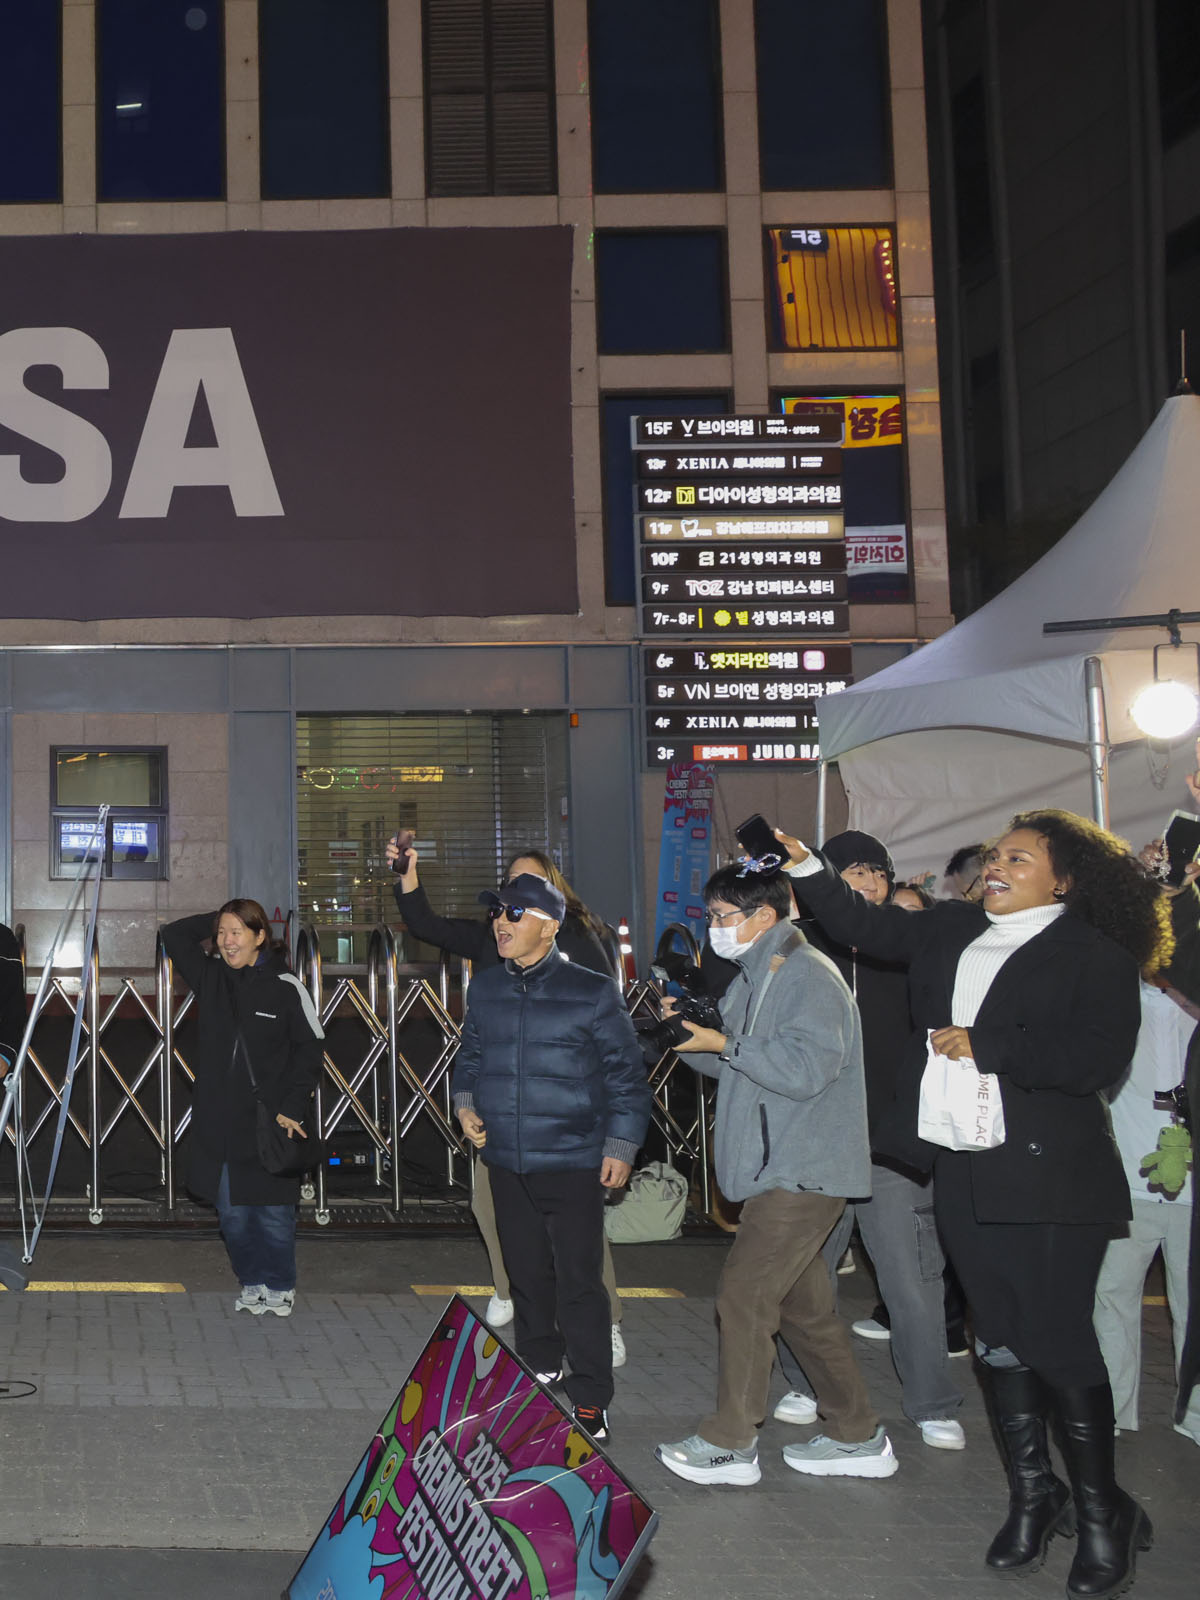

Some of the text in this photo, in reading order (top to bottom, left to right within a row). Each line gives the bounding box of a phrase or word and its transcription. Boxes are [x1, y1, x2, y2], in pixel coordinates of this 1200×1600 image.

[645, 421, 673, 435] 15F
[697, 419, 755, 436] 브이의원
[677, 457, 730, 470] XENIA
[644, 488, 672, 503] 12F
[698, 486, 842, 505] 디아이성형외과의원
[649, 522, 673, 535] 11F
[650, 552, 679, 566] 10F
[652, 582, 670, 595] 9F
[685, 579, 725, 597] TOZ
[653, 612, 696, 626] 7F~8F
[751, 610, 835, 626] 성형외과의원
[656, 653, 674, 668] 6F
[657, 685, 675, 698] 5F
[684, 682, 711, 700] VN
[655, 716, 671, 729] 4F
[686, 716, 740, 729] XENIA
[657, 747, 675, 760] 3F
[752, 744, 796, 760] JUNO
[463, 1432, 511, 1500] 2025
[710, 1453, 735, 1466] HOKA
[412, 1430, 524, 1600] CHEMISTREET
[395, 1491, 473, 1600] FESTIVA
